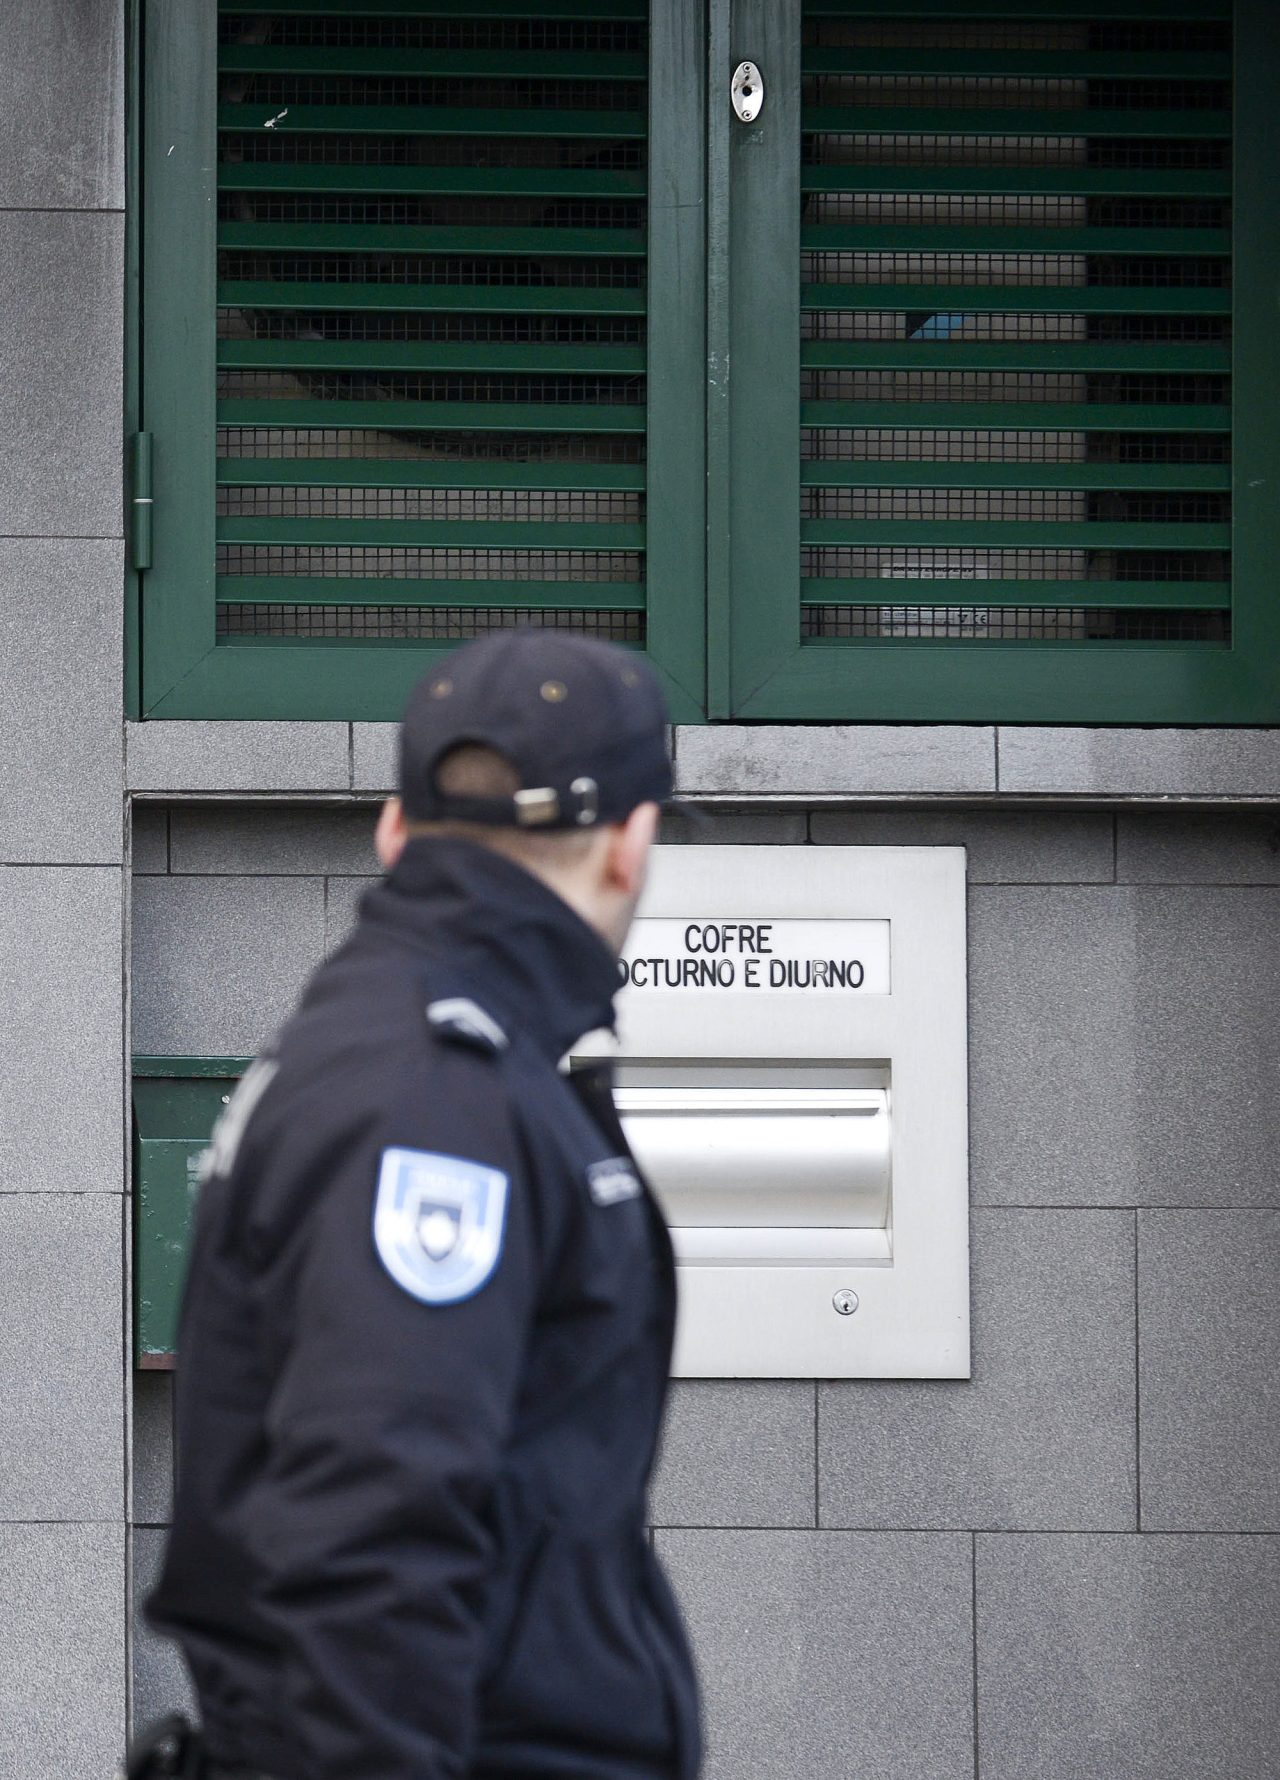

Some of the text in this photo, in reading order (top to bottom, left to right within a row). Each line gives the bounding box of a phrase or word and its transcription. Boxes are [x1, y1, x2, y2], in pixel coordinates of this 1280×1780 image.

[684, 924, 772, 954] COFRE
[618, 958, 864, 988] OCTURNO E DIURNO
